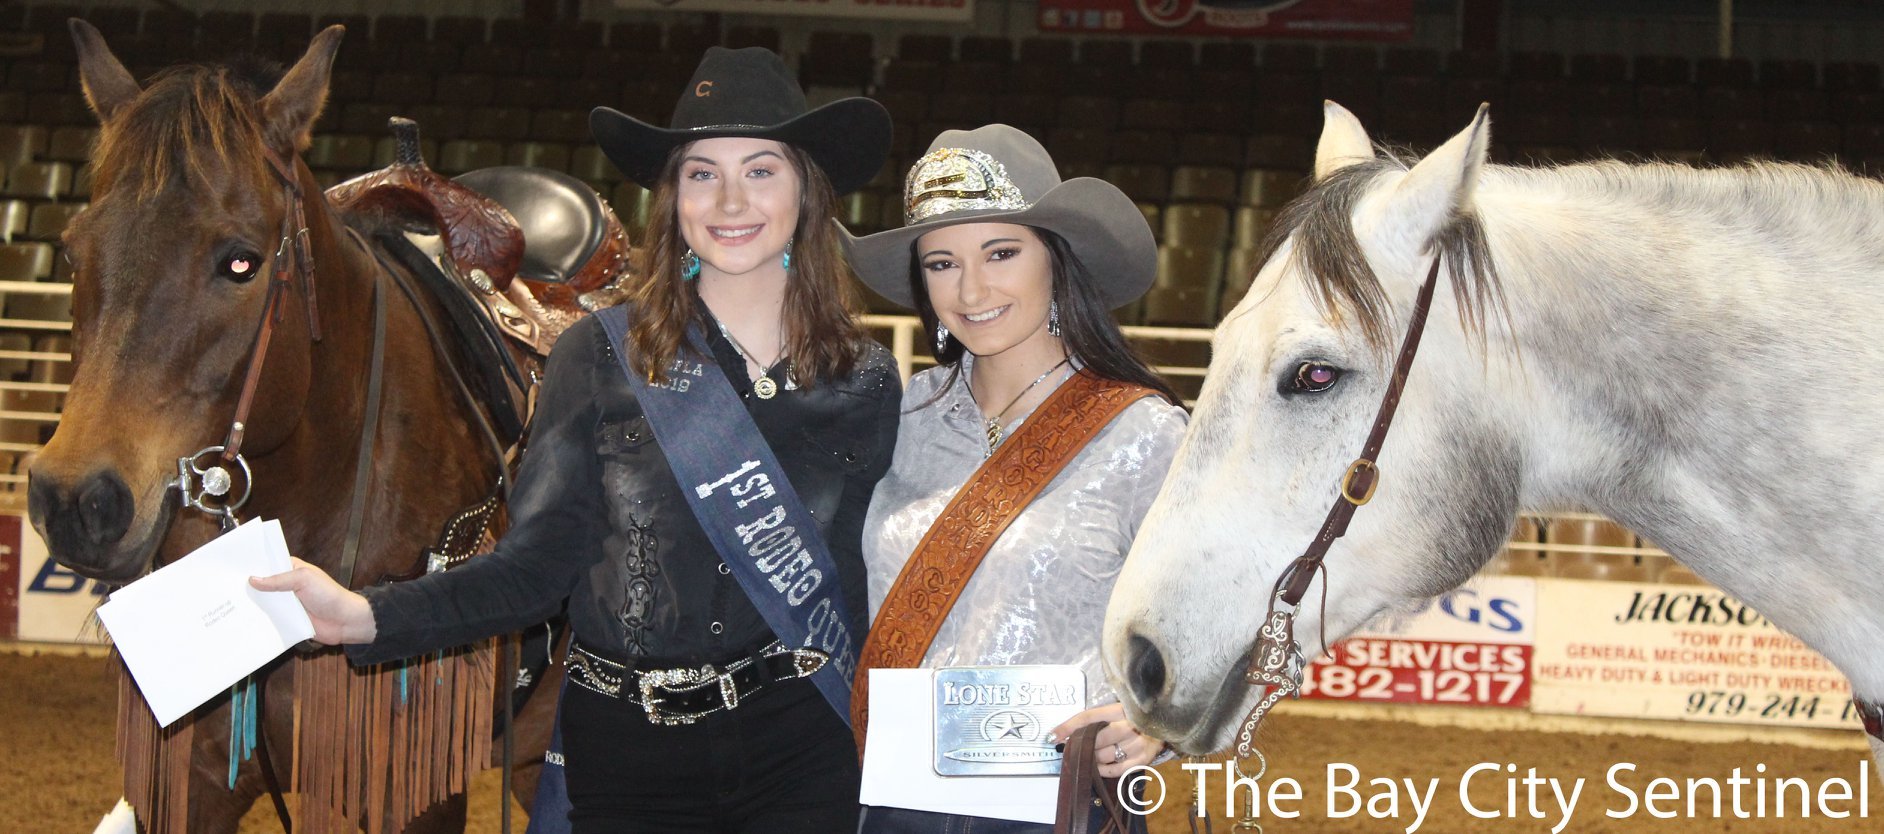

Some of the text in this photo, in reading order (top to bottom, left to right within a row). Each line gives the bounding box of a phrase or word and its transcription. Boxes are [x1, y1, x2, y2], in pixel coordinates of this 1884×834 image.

[695, 460, 776, 509] 1ST
[735, 505, 823, 607] RODEO
[1615, 591, 1768, 628] JACKSO
[1566, 643, 1648, 662] GENERAL
[1728, 633, 1747, 648] IT
[1752, 633, 1806, 650] WRIG
[1346, 638, 1526, 674] SERVICES
[1539, 664, 1596, 681] HEAVY
[1601, 667, 1647, 683] DUTY
[1652, 670, 1663, 684] &
[1669, 671, 1720, 686] LIGHT
[1727, 673, 1772, 689] DUTY
[943, 681, 1077, 706] LONE STAR
[1686, 691, 1858, 722] 979-244-1
[545, 749, 565, 767] ROD
